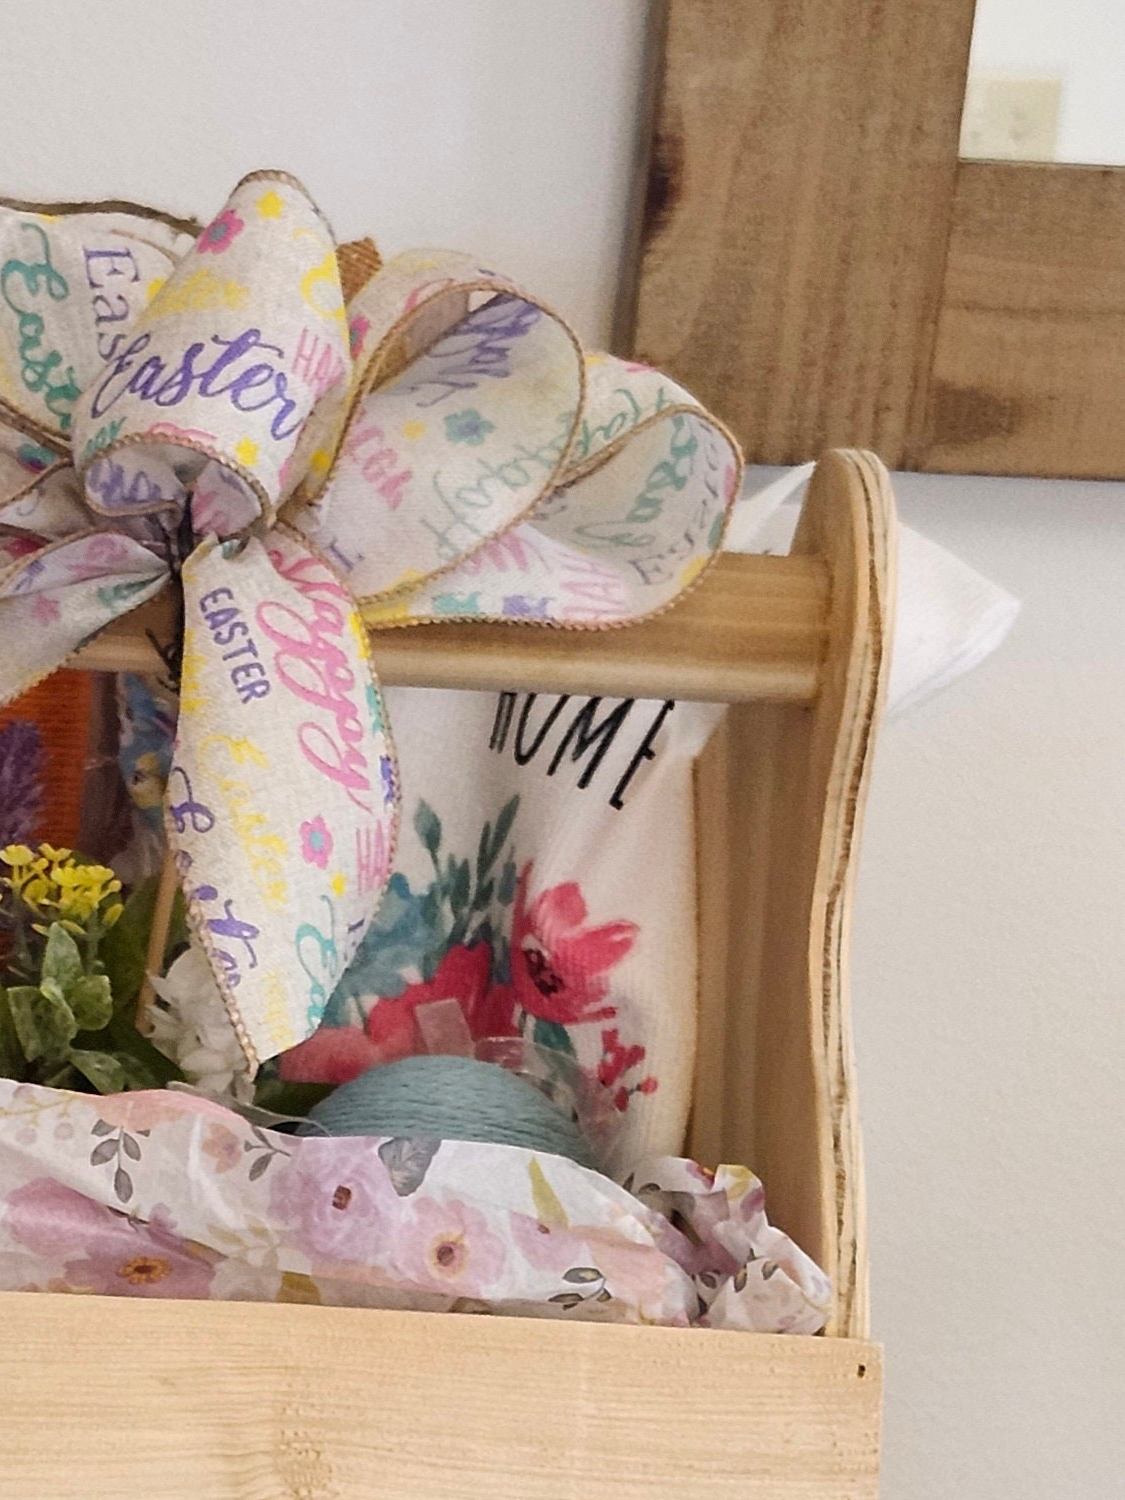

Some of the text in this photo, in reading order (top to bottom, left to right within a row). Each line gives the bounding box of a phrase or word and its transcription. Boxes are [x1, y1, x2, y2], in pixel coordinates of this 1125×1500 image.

[91, 328, 305, 442] Easter
[199, 586, 271, 704] EASTER
[256, 546, 372, 812] Happy
